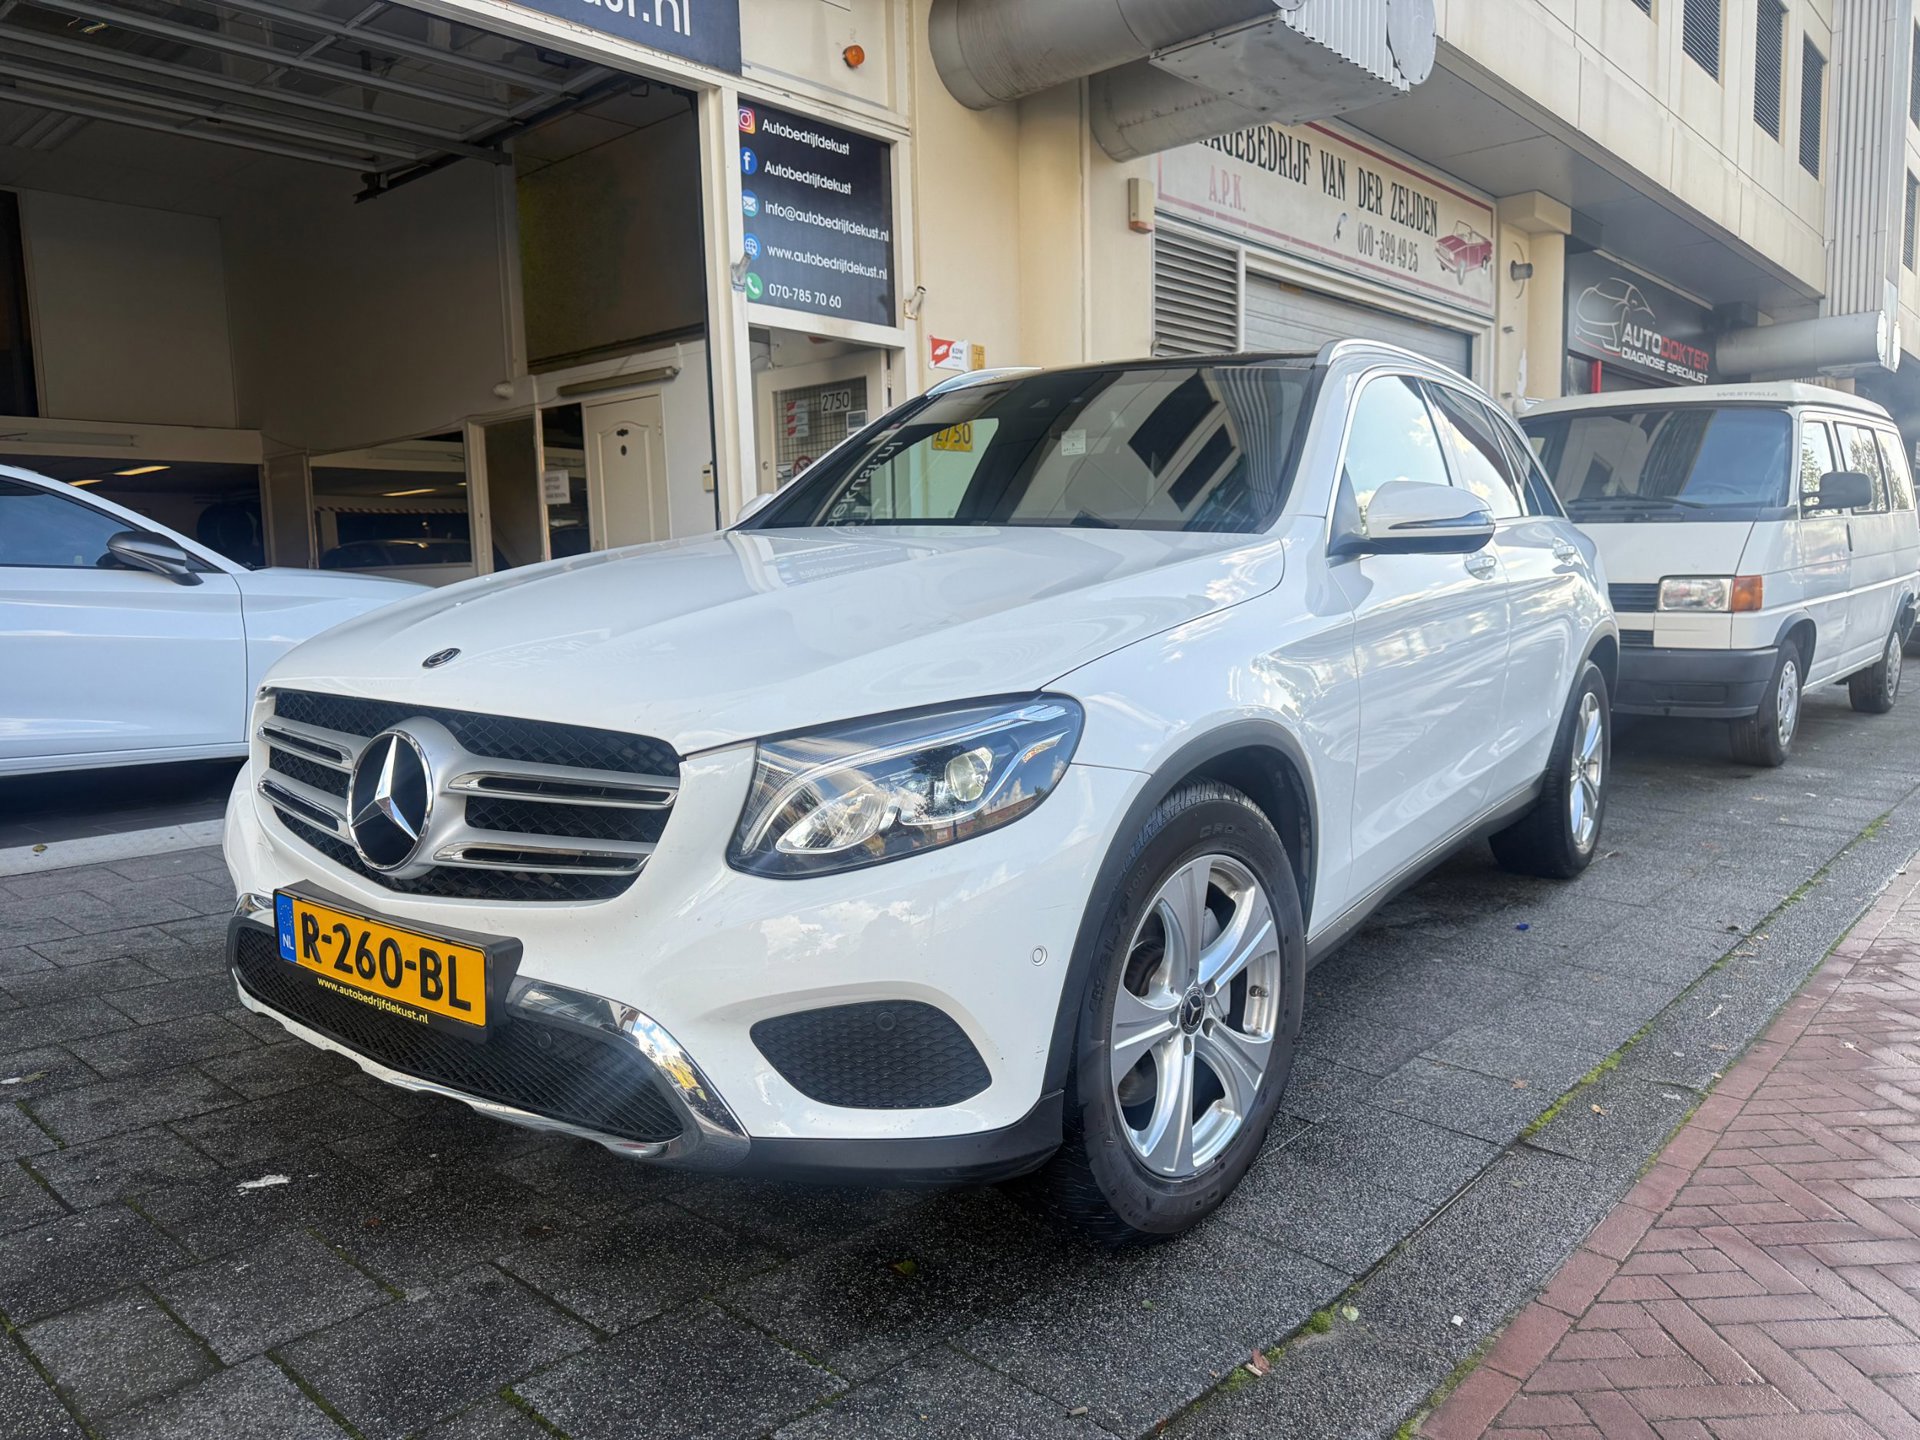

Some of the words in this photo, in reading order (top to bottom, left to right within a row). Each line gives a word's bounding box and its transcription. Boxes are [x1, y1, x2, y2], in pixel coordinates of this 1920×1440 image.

[762, 118, 850, 155] Autobedrijfdekust
[764, 160, 852, 195] Autobedrijfdekust
[1209, 165, 1246, 212] A.P.K.
[1320, 149, 1346, 201] VAN
[1358, 166, 1383, 216] DER
[1390, 181, 1438, 238] ZEIJDEN
[765, 200, 889, 242] info@autobedrijfdekust.nl
[766, 244, 888, 280] www.autobedrijfdekust.nl
[768, 282, 812, 303] 070-785
[814, 292, 827, 306] 70
[829, 294, 842, 308] 60
[1621, 322, 1710, 371] AUTODOKTER
[1621, 346, 1666, 372] DIAGNOSE
[1666, 361, 1709, 385] SPECIALIST
[822, 391, 850, 412] 2750
[282, 933, 295, 951] NL
[301, 912, 472, 1012] R-260-BL
[317, 976, 429, 1024] www.autobedrijfdekust.nl
